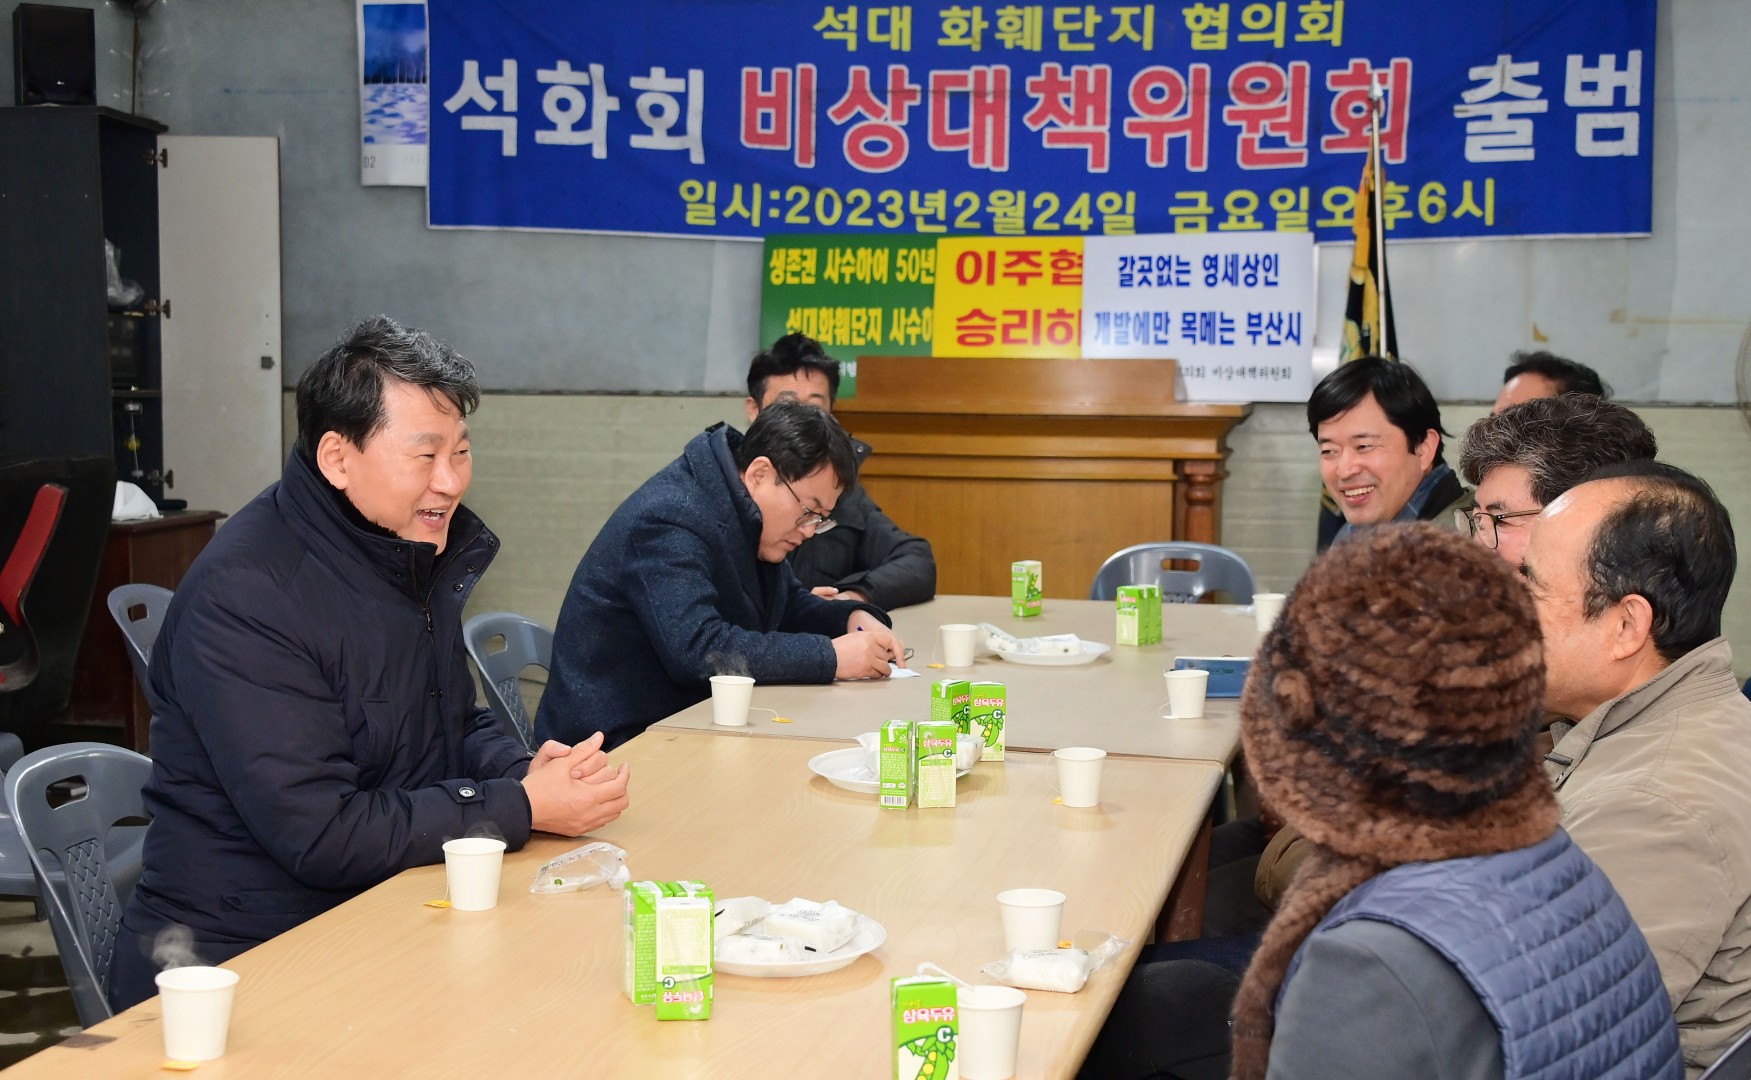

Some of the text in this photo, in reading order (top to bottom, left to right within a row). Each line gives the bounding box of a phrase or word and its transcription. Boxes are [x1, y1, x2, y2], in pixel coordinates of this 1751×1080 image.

[813, 0, 1345, 51] 석대 화훼단지 협의회
[443, 49, 1643, 173] 석화회 비상대책위원회 출범
[769, 247, 936, 286] 생존권 사수하여 50년
[1118, 253, 1279, 288] 갈곳없는 영세상인
[1094, 311, 1302, 346] 개발에만 목메는 부산시
[902, 1006, 956, 1024] 삼육두유
[937, 1027, 951, 1043] C
